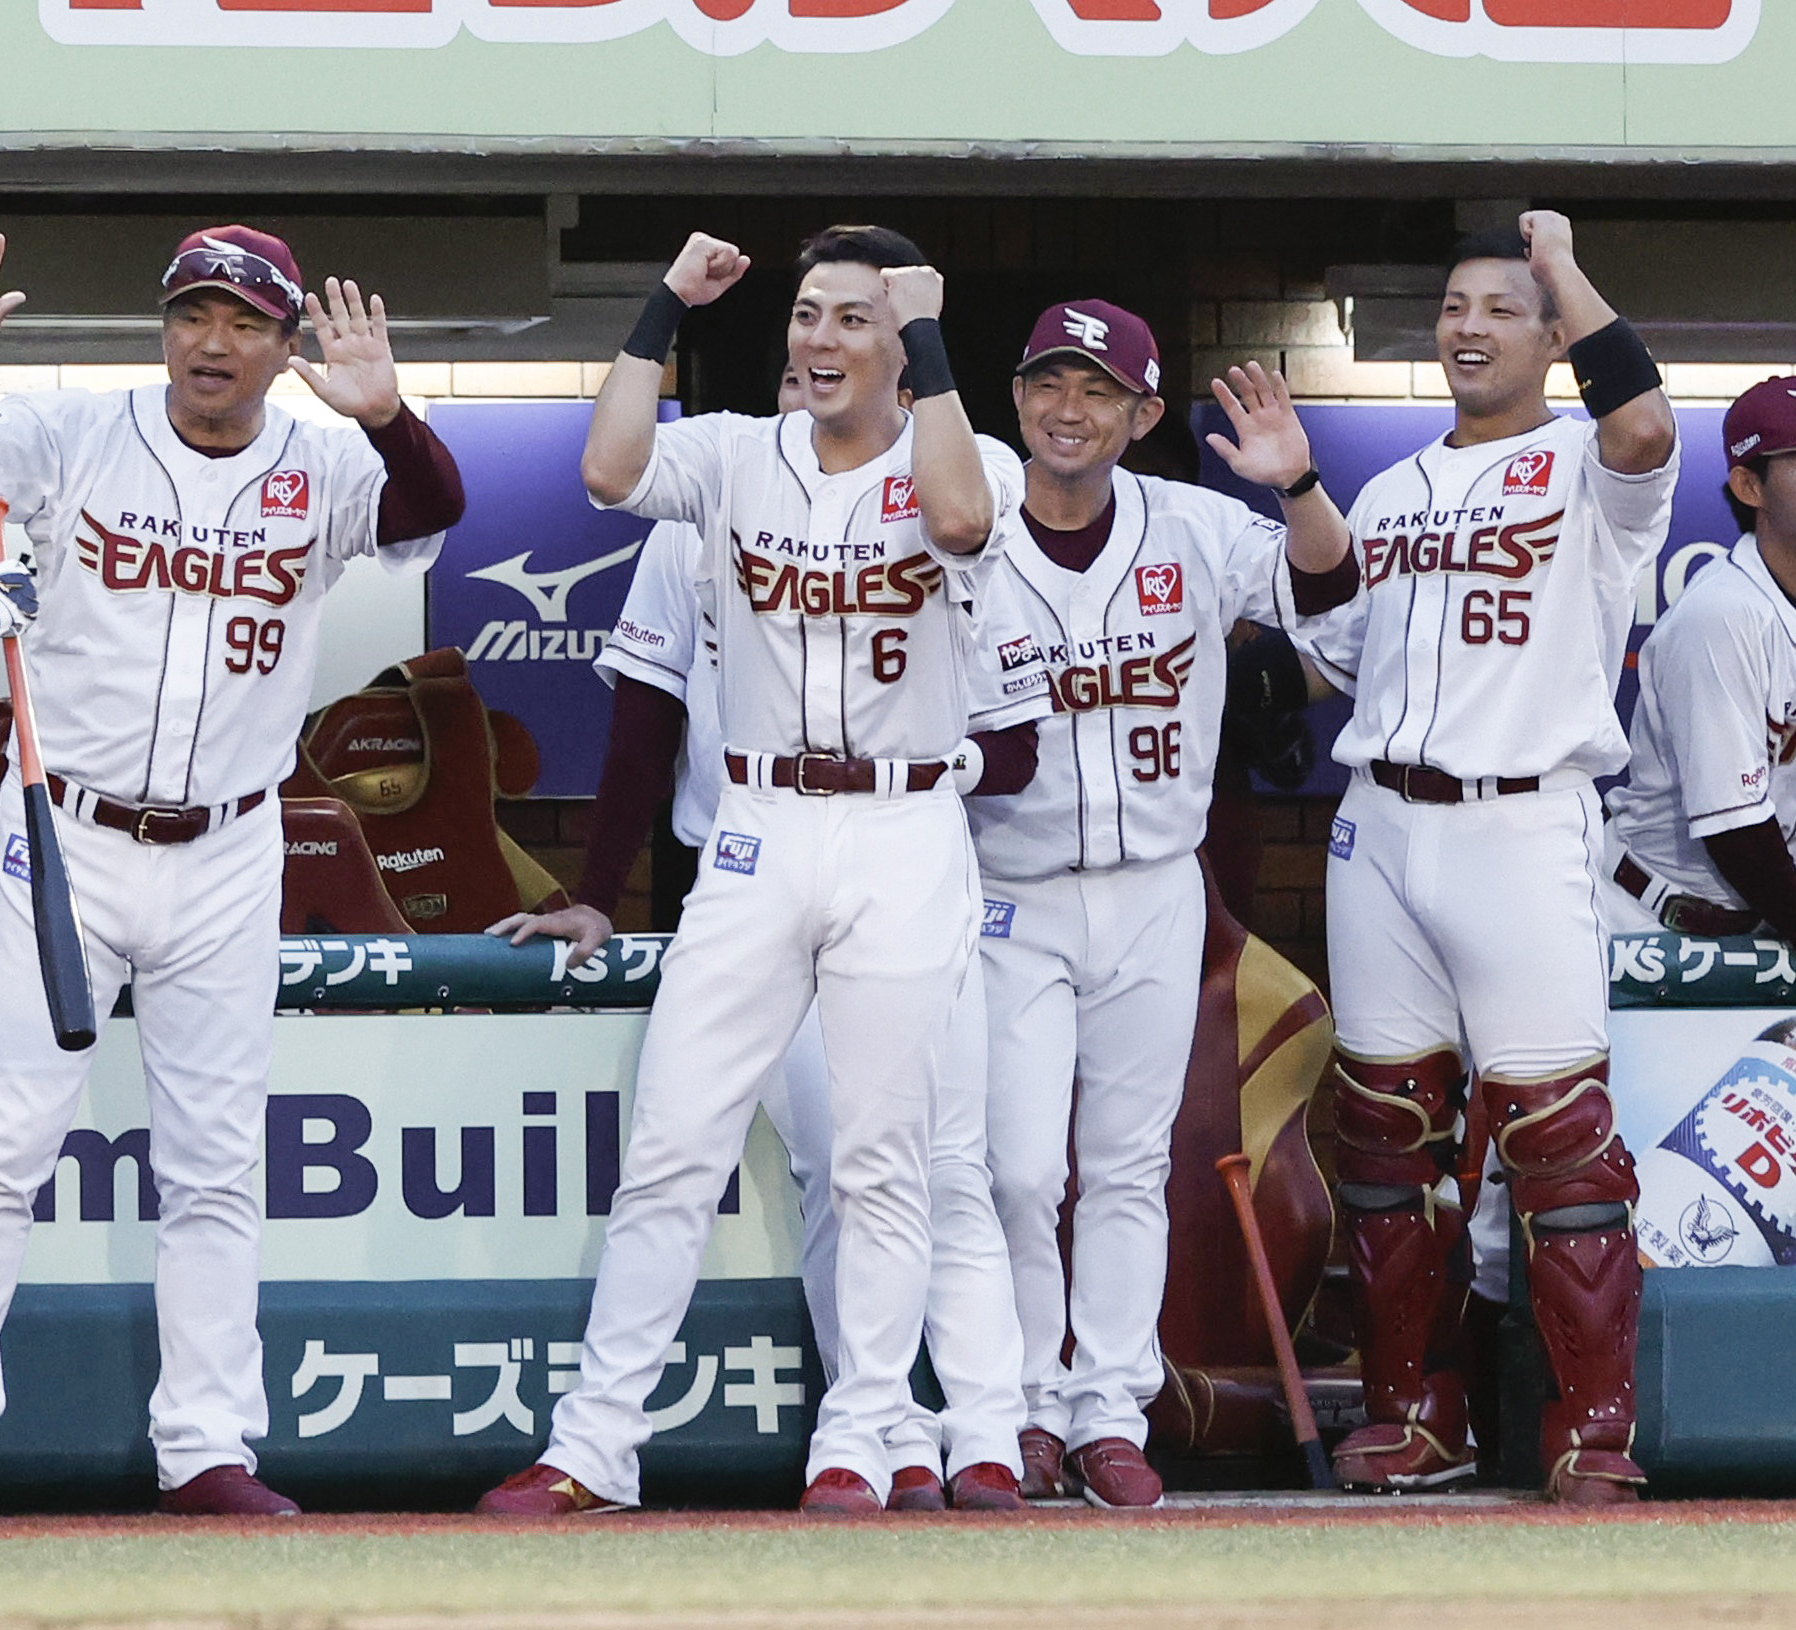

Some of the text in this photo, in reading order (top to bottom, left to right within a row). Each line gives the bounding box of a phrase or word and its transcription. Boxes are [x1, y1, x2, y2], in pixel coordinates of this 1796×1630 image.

[118, 510, 267, 548] RAKUTEN
[1376, 505, 1505, 532] RAKUTEN
[77, 509, 318, 608] EAGLES
[755, 530, 887, 562] RAKUTEN
[1362, 508, 1564, 592] EAGLES
[734, 528, 942, 617] EAGLES
[1460, 590, 1533, 647] 65
[224, 616, 285, 676] 99
[871, 627, 908, 684] 6
[1128, 721, 1182, 782] 96
[376, 846, 445, 873] Rakuten
[720, 833, 759, 860] Fuji
[279, 938, 413, 986] デンキ
[1610, 937, 1666, 984] K's
